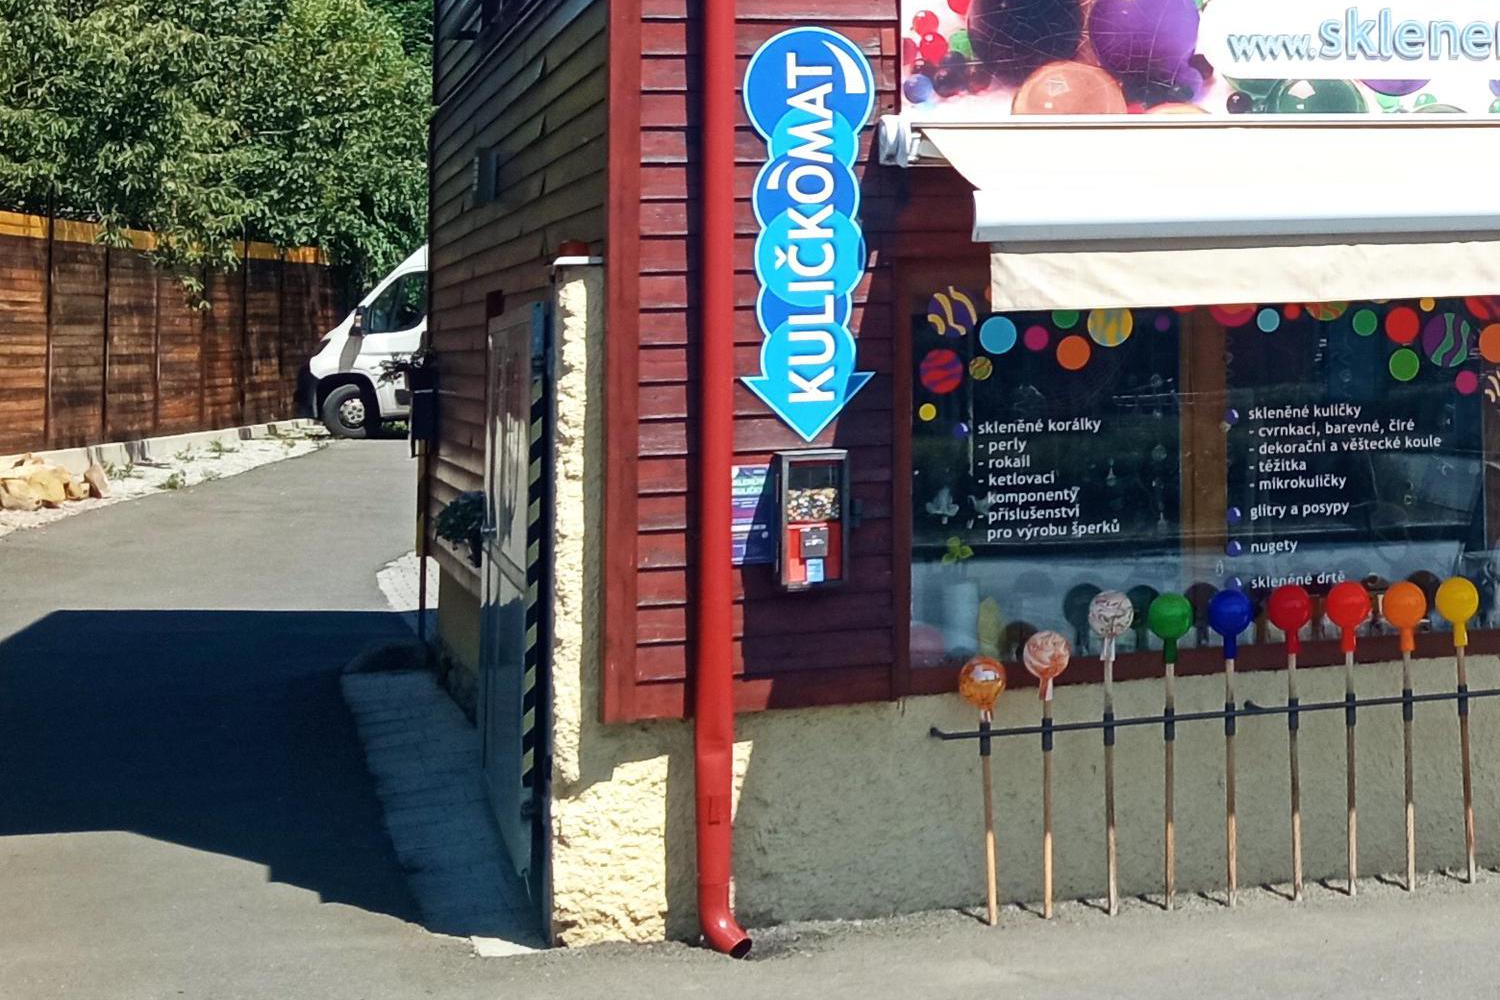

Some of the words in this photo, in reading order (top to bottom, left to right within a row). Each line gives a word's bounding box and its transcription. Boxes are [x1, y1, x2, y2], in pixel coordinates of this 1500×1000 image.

[774, 51, 836, 403] KULIČKOMAT
[1248, 405, 1310, 420] skleněné
[1313, 403, 1362, 419] kuličky
[977, 418, 1044, 435] skleněné
[1048, 417, 1102, 434] korálky
[1325, 421, 1385, 435] barevné,
[988, 437, 1027, 454] perly
[1329, 442, 1338, 452] a
[1342, 436, 1401, 451] věštecké
[1404, 434, 1442, 448] koule
[988, 454, 1031, 469] rokail
[1258, 474, 1347, 491] mikrokuličky
[988, 503, 1081, 525] příslušenství
[1290, 505, 1299, 515] a
[1302, 502, 1350, 517] posypy
[987, 527, 1012, 542] pro
[1016, 523, 1067, 541] výrobu
[1071, 518, 1120, 538] šperků
[1250, 539, 1298, 555] nugety
